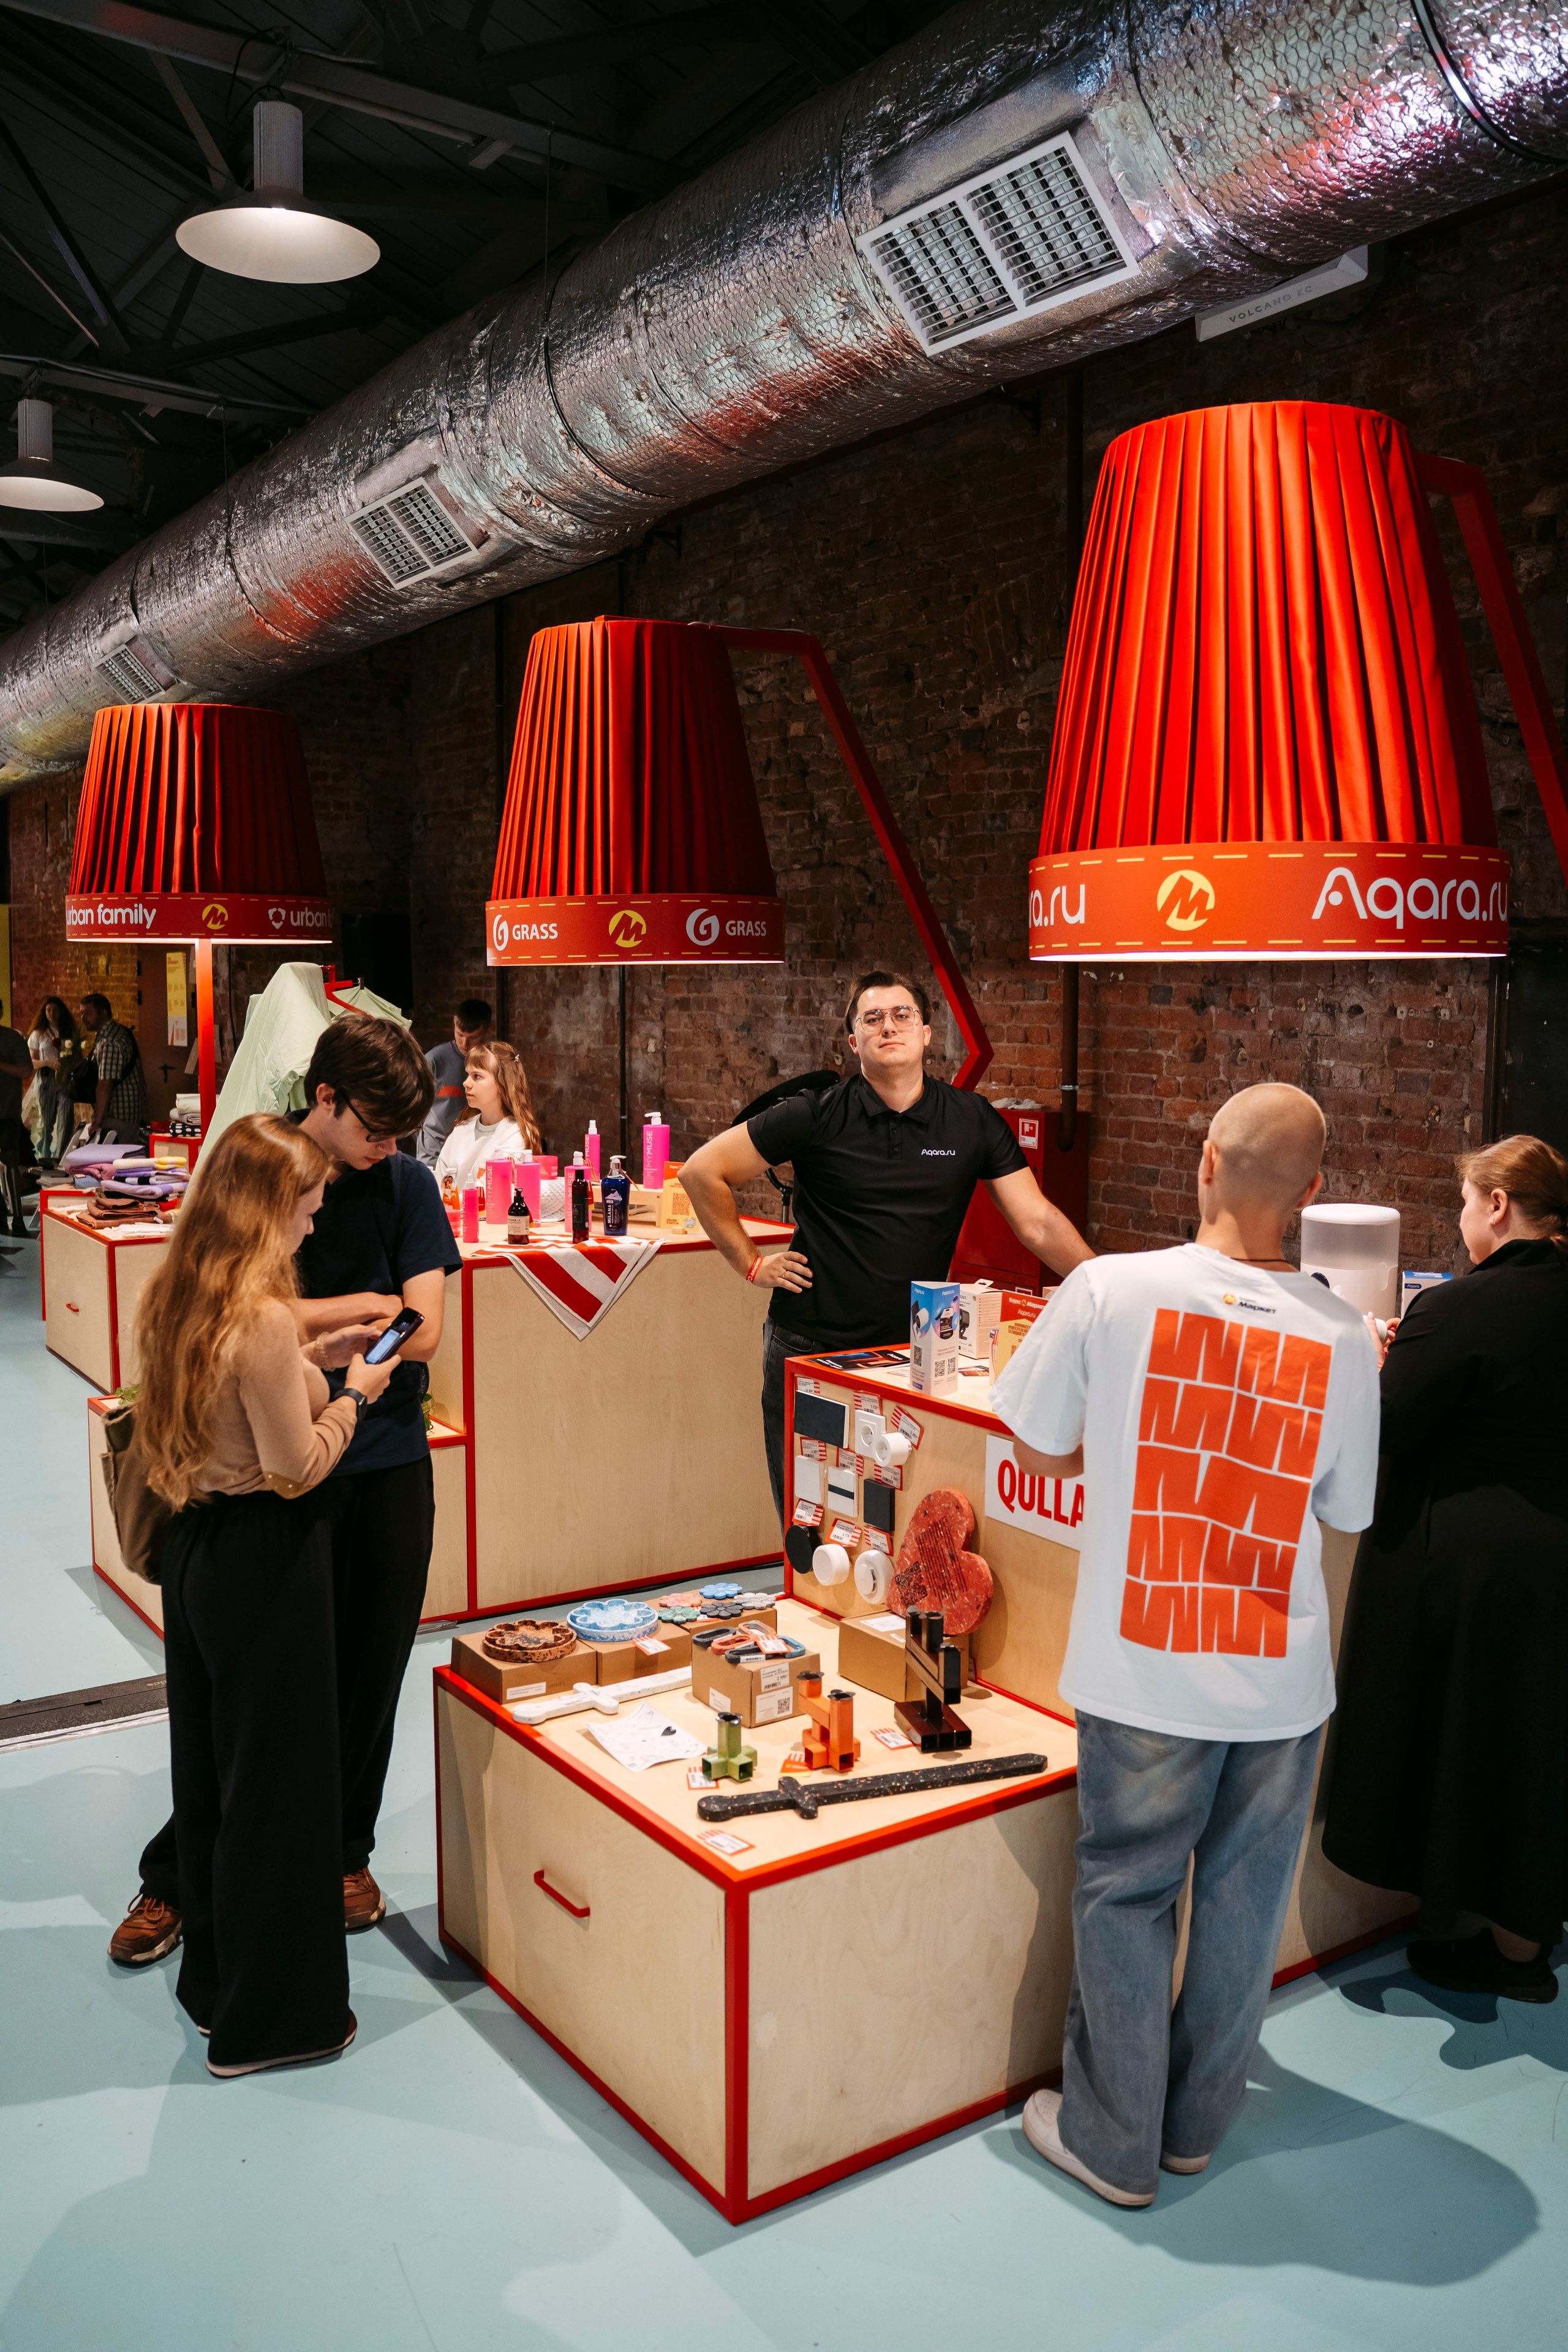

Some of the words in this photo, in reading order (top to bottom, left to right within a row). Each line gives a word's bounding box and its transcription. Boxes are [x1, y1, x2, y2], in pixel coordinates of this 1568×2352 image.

[1229, 294, 1291, 323] VOLCANO
[1297, 285, 1313, 298] EC
[1311, 867, 1508, 929] Aqara.ru
[66, 905, 94, 925] urban
[97, 903, 157, 929] family
[290, 907, 327, 927] urban
[512, 922, 559, 940] GRASS
[725, 920, 767, 937] GRASS
[1238, 1301, 1276, 1314] Маркет
[997, 1459, 1085, 1528] QULLA
